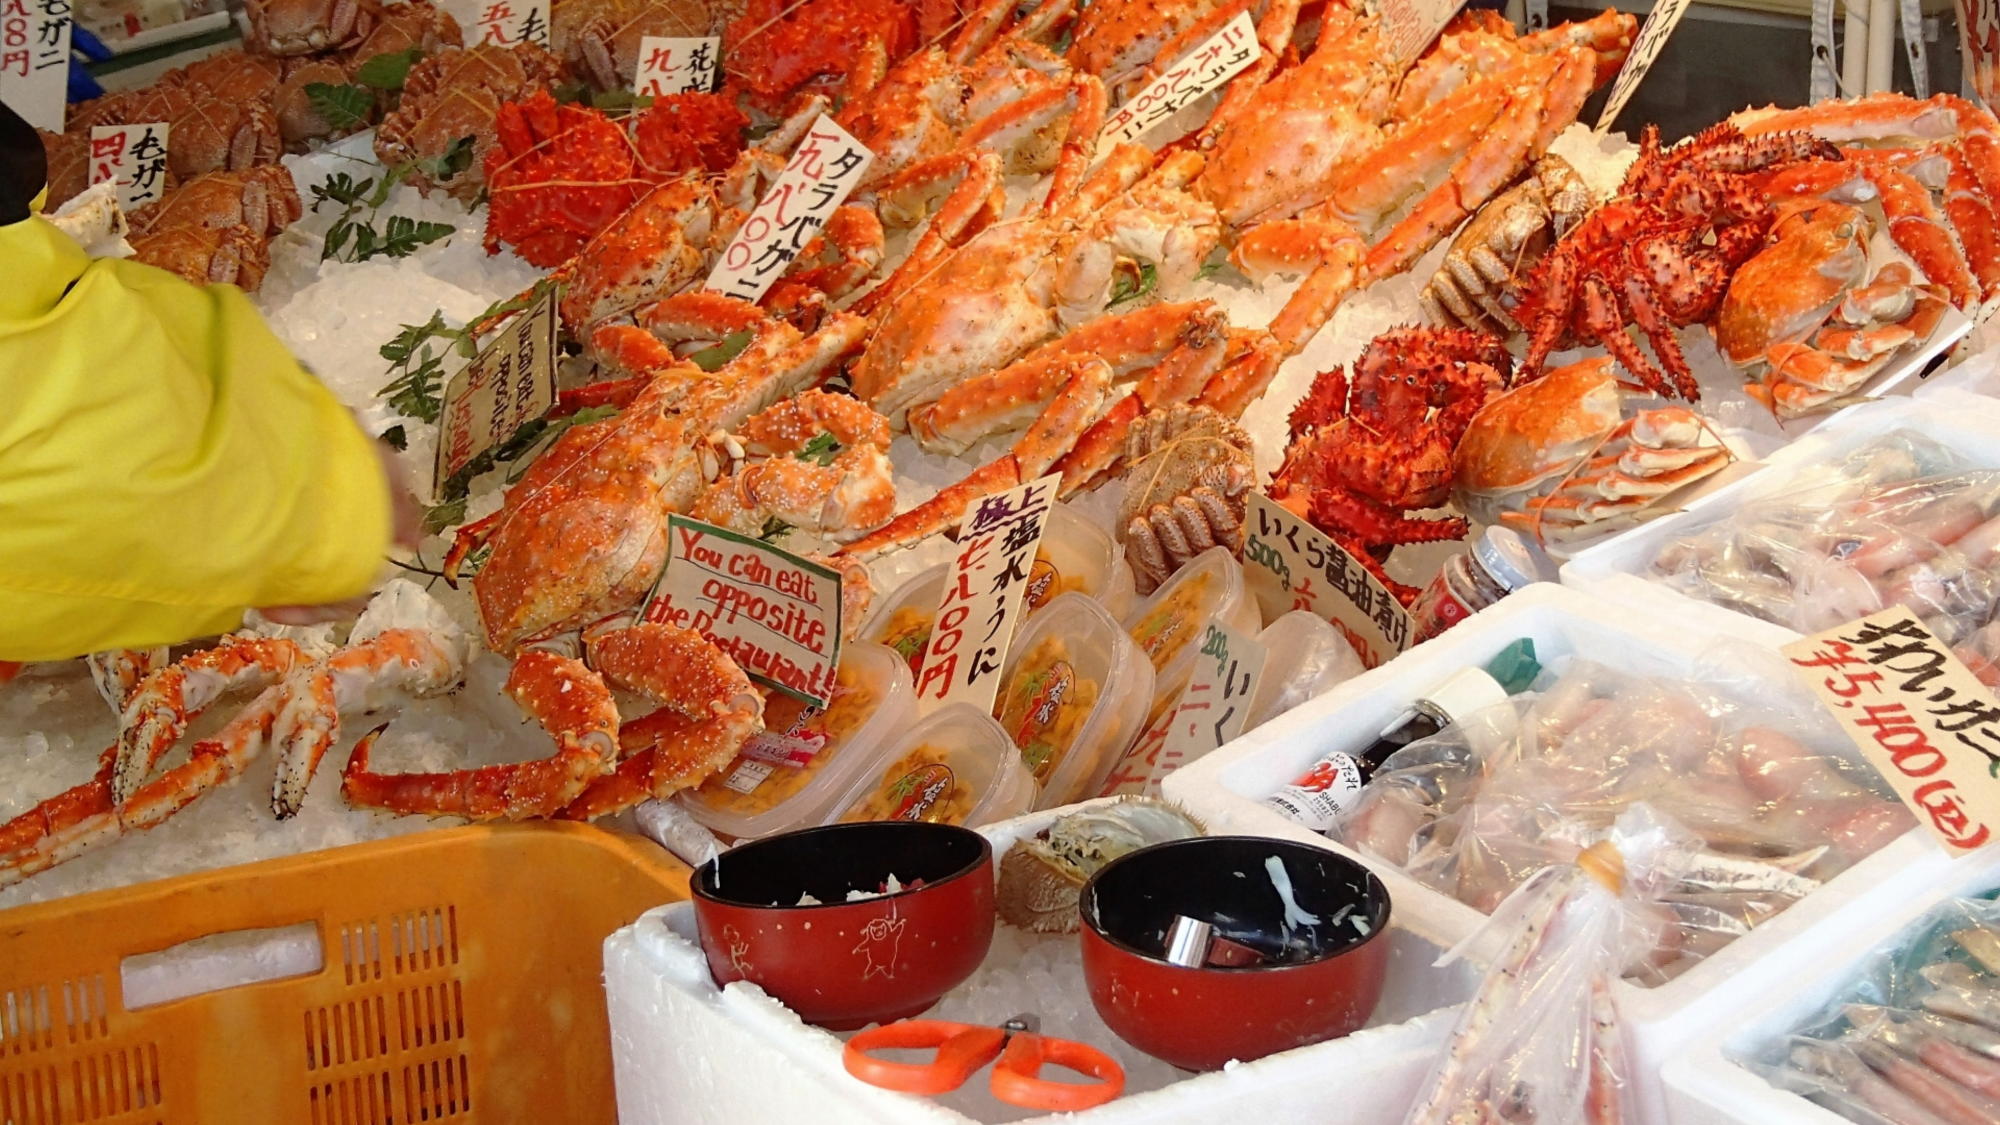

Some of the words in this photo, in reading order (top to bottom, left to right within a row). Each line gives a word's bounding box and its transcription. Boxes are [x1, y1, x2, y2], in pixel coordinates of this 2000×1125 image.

[1122, 47, 1250, 141] タラバガニ
[725, 148, 864, 302] タラバガニ
[679, 526, 724, 570] You
[728, 554, 772, 586] can
[775, 570, 818, 604] eat
[1245, 534, 1291, 593] 500g
[644, 593, 690, 627] the
[702, 578, 826, 654] opposite
